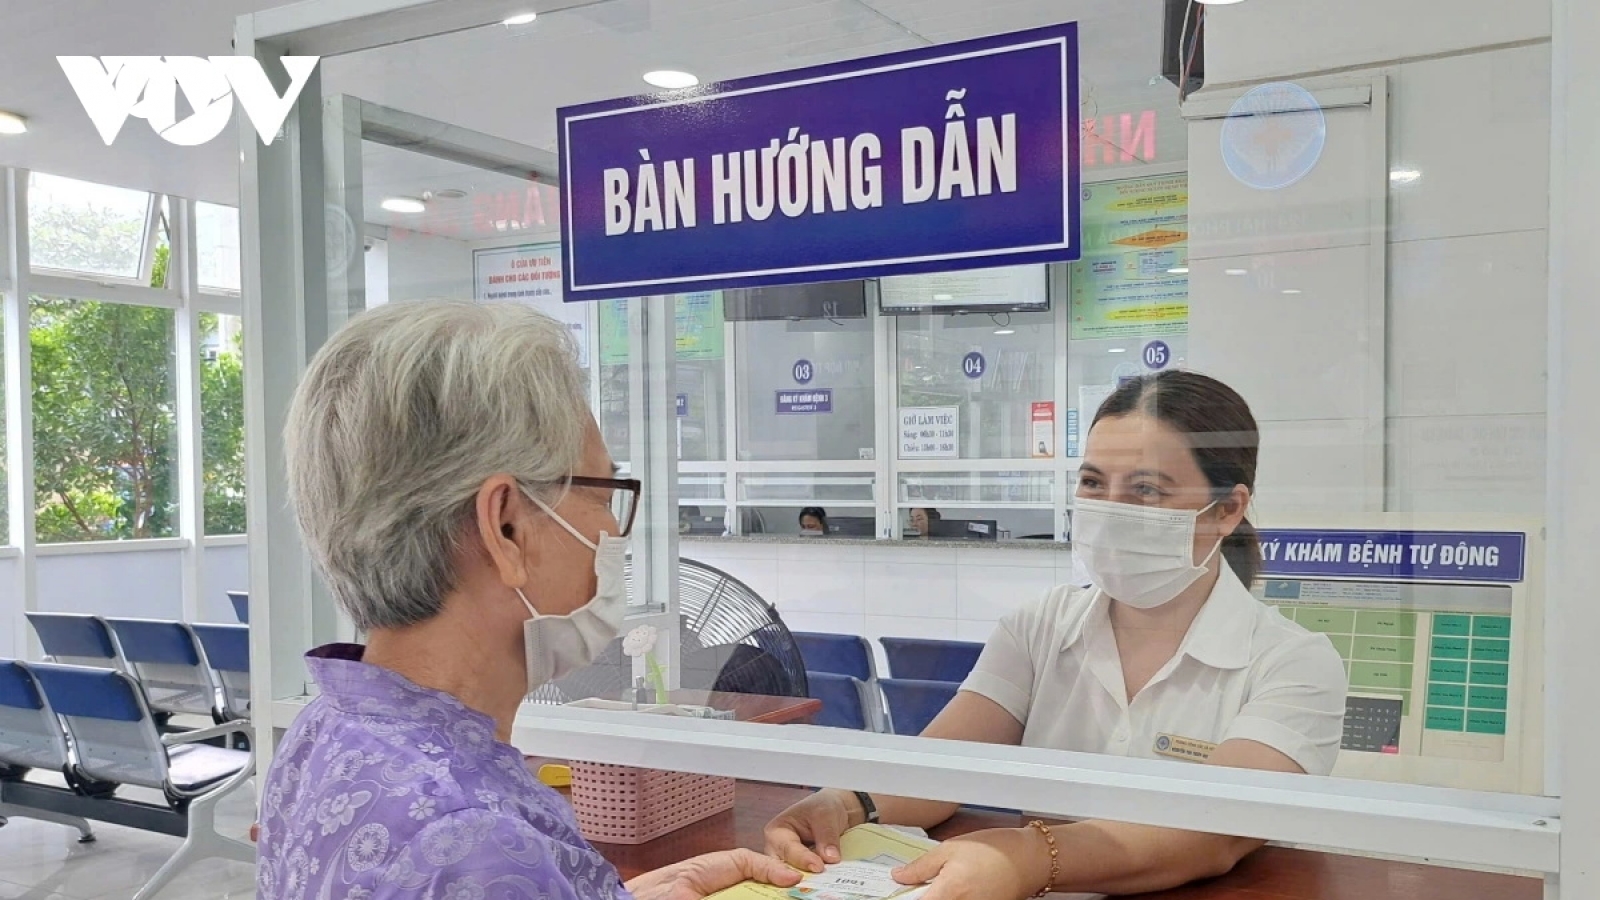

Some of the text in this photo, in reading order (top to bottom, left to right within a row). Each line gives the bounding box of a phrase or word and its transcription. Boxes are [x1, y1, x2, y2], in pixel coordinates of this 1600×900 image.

[604, 88, 1017, 237] BÀN HƯỚNG DẪN
[1146, 348, 1166, 365] 05
[795, 364, 810, 380] 03
[965, 357, 982, 373] 04
[903, 412, 953, 426] GIỜ LÀM VIỆC
[1284, 538, 1342, 563] KHÁM
[1348, 540, 1402, 568] BỆNH
[1409, 543, 1436, 569] TỰ
[1440, 541, 1499, 570] ĐỘNG
